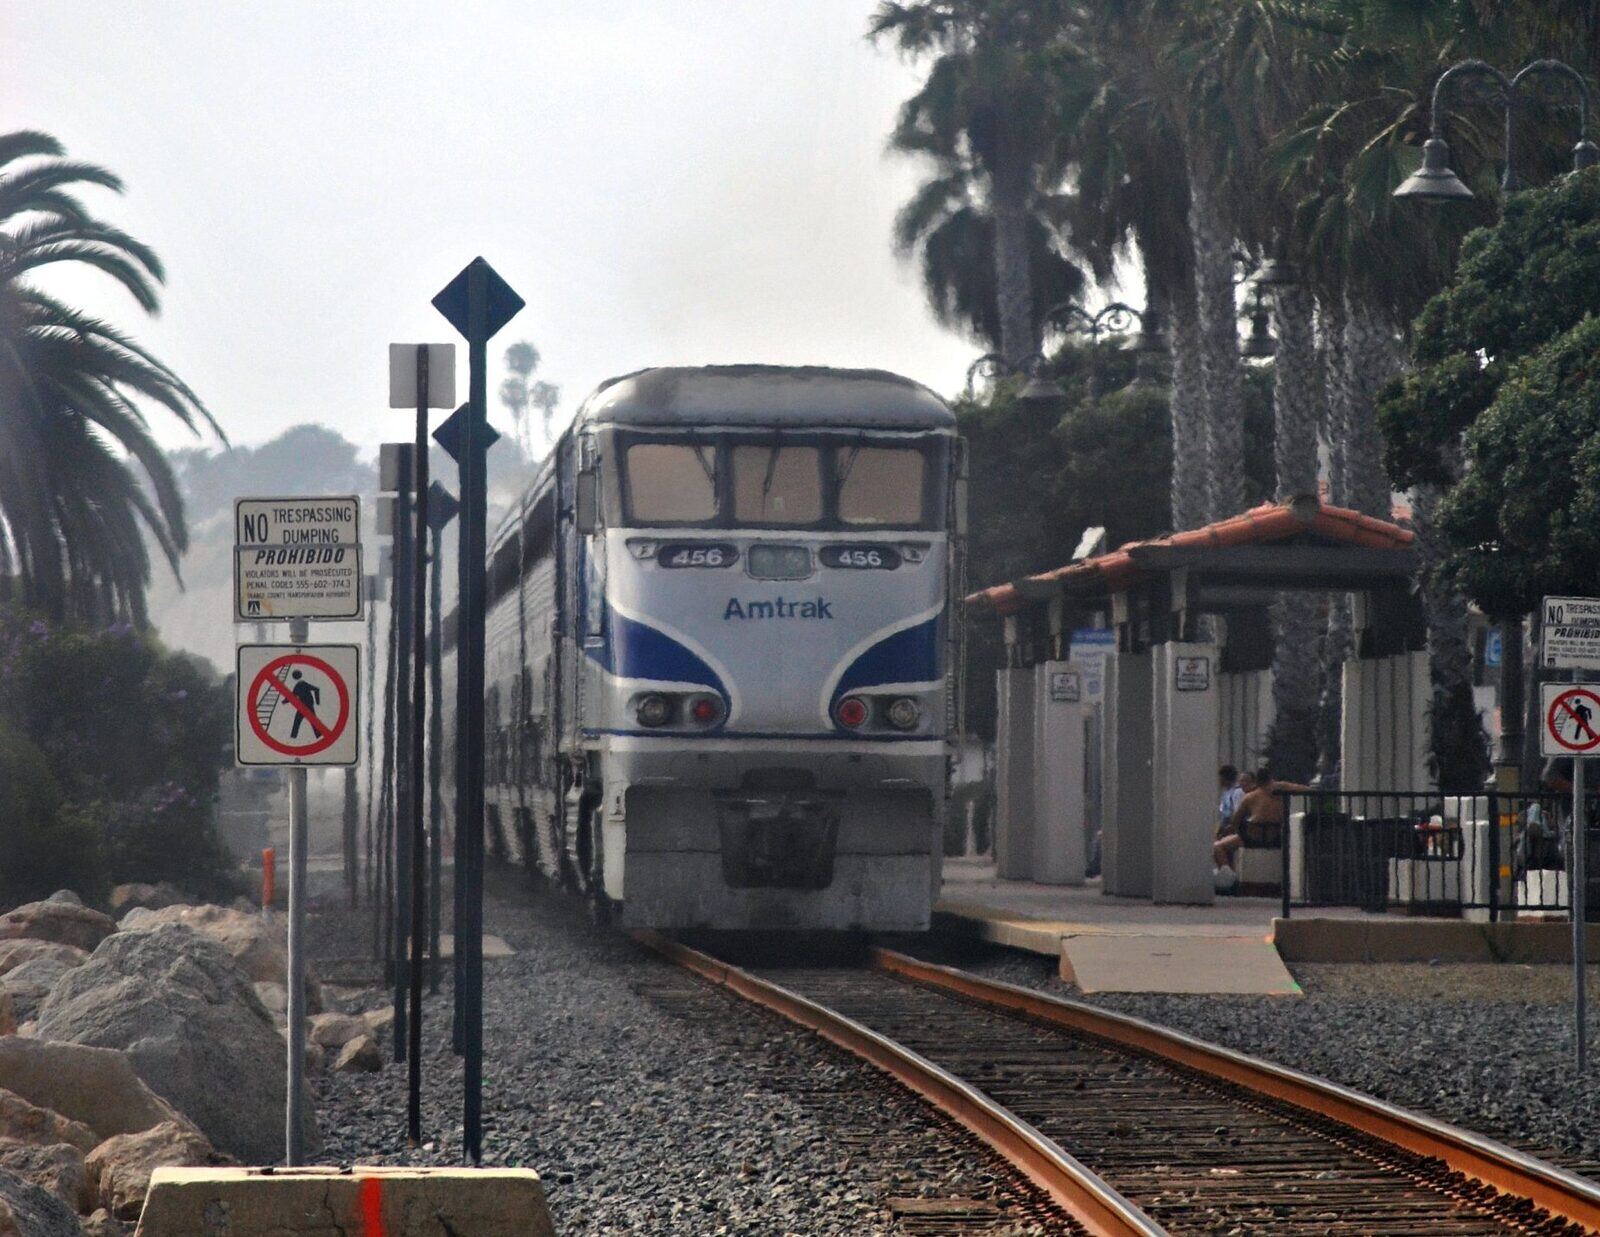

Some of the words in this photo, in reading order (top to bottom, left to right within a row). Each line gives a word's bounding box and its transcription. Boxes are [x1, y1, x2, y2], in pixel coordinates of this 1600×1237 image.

[272, 507, 352, 523] TRESPASSING
[244, 513, 268, 543] NO
[282, 528, 339, 544] DUMPING
[254, 548, 346, 565] PROHIBIDO
[672, 549, 724, 565] 456
[839, 551, 882, 566] 456
[245, 570, 279, 578] VIOLATORS
[310, 568, 352, 577] PROSECUTED
[246, 581, 267, 589] PENAL
[271, 580, 294, 589] CODES
[724, 597, 833, 620] Amtrak
[1549, 605, 1564, 624] NO
